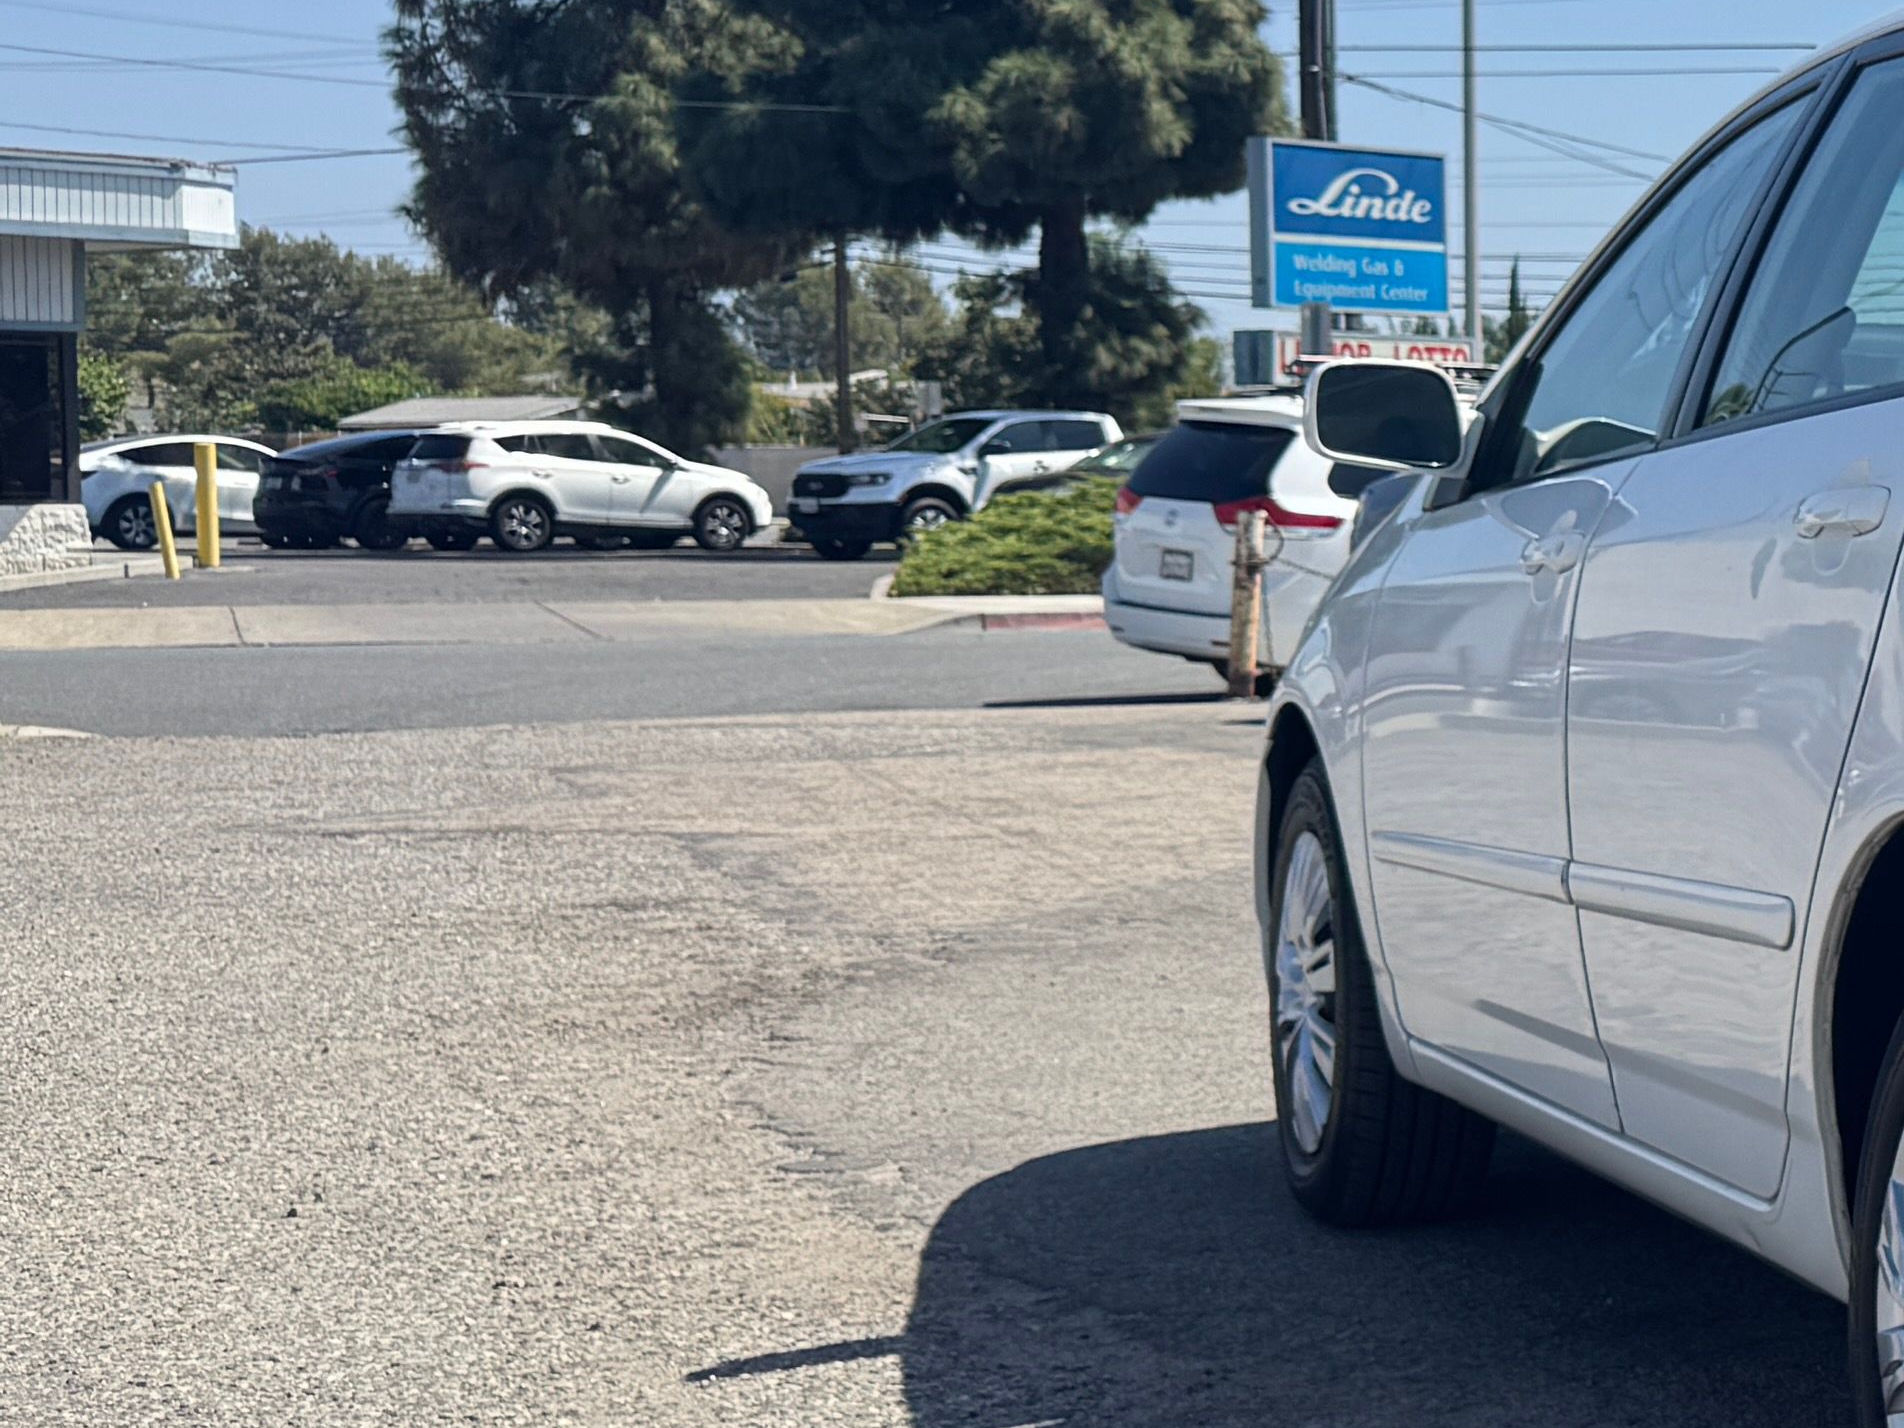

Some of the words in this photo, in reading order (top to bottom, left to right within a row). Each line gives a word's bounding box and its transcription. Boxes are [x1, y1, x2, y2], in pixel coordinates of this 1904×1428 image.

[1286, 167, 1432, 223] Linde
[1292, 253, 1356, 278] Welding
[1361, 257, 1389, 276] Gas
[1293, 280, 1376, 302] Equipment
[1381, 284, 1428, 302] Center
